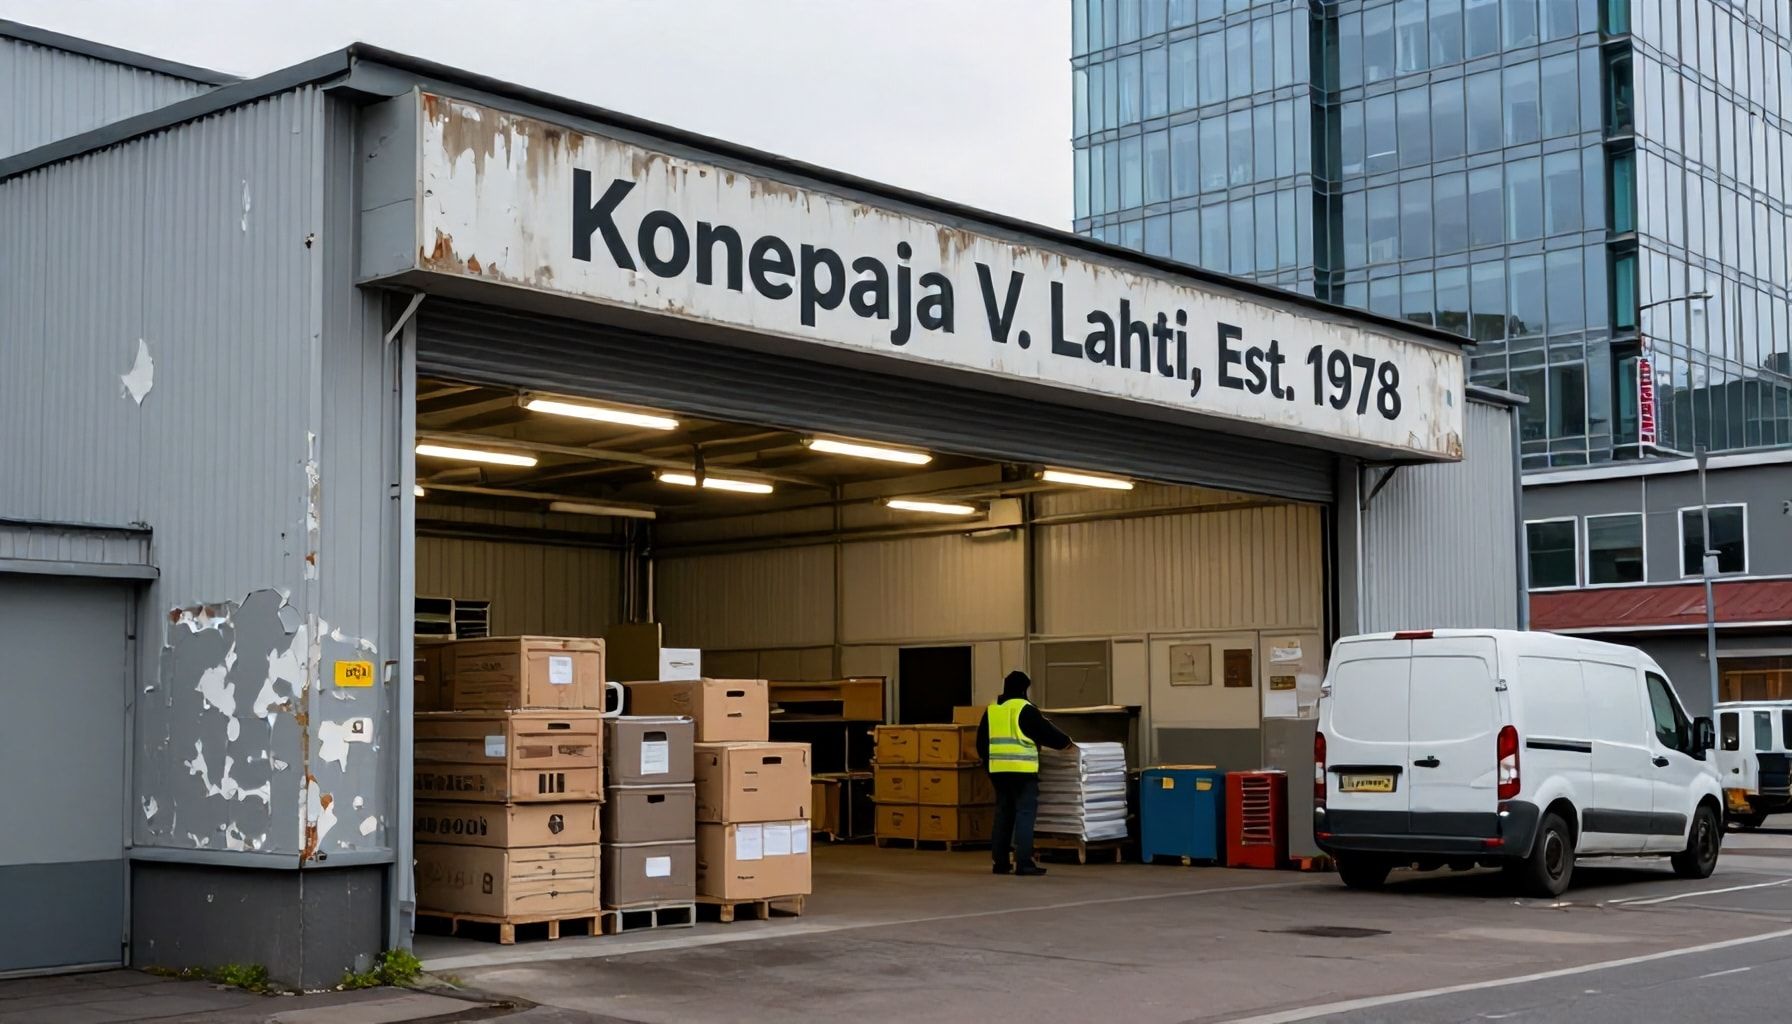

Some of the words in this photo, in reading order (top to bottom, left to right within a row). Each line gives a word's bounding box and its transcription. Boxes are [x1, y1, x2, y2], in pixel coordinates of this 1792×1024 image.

[572, 167, 955, 346] Konepaja
[975, 262, 1031, 350] V.
[1050, 281, 1202, 398] Lahti,
[1217, 321, 1295, 402] Est.
[1307, 344, 1402, 421] 1978
